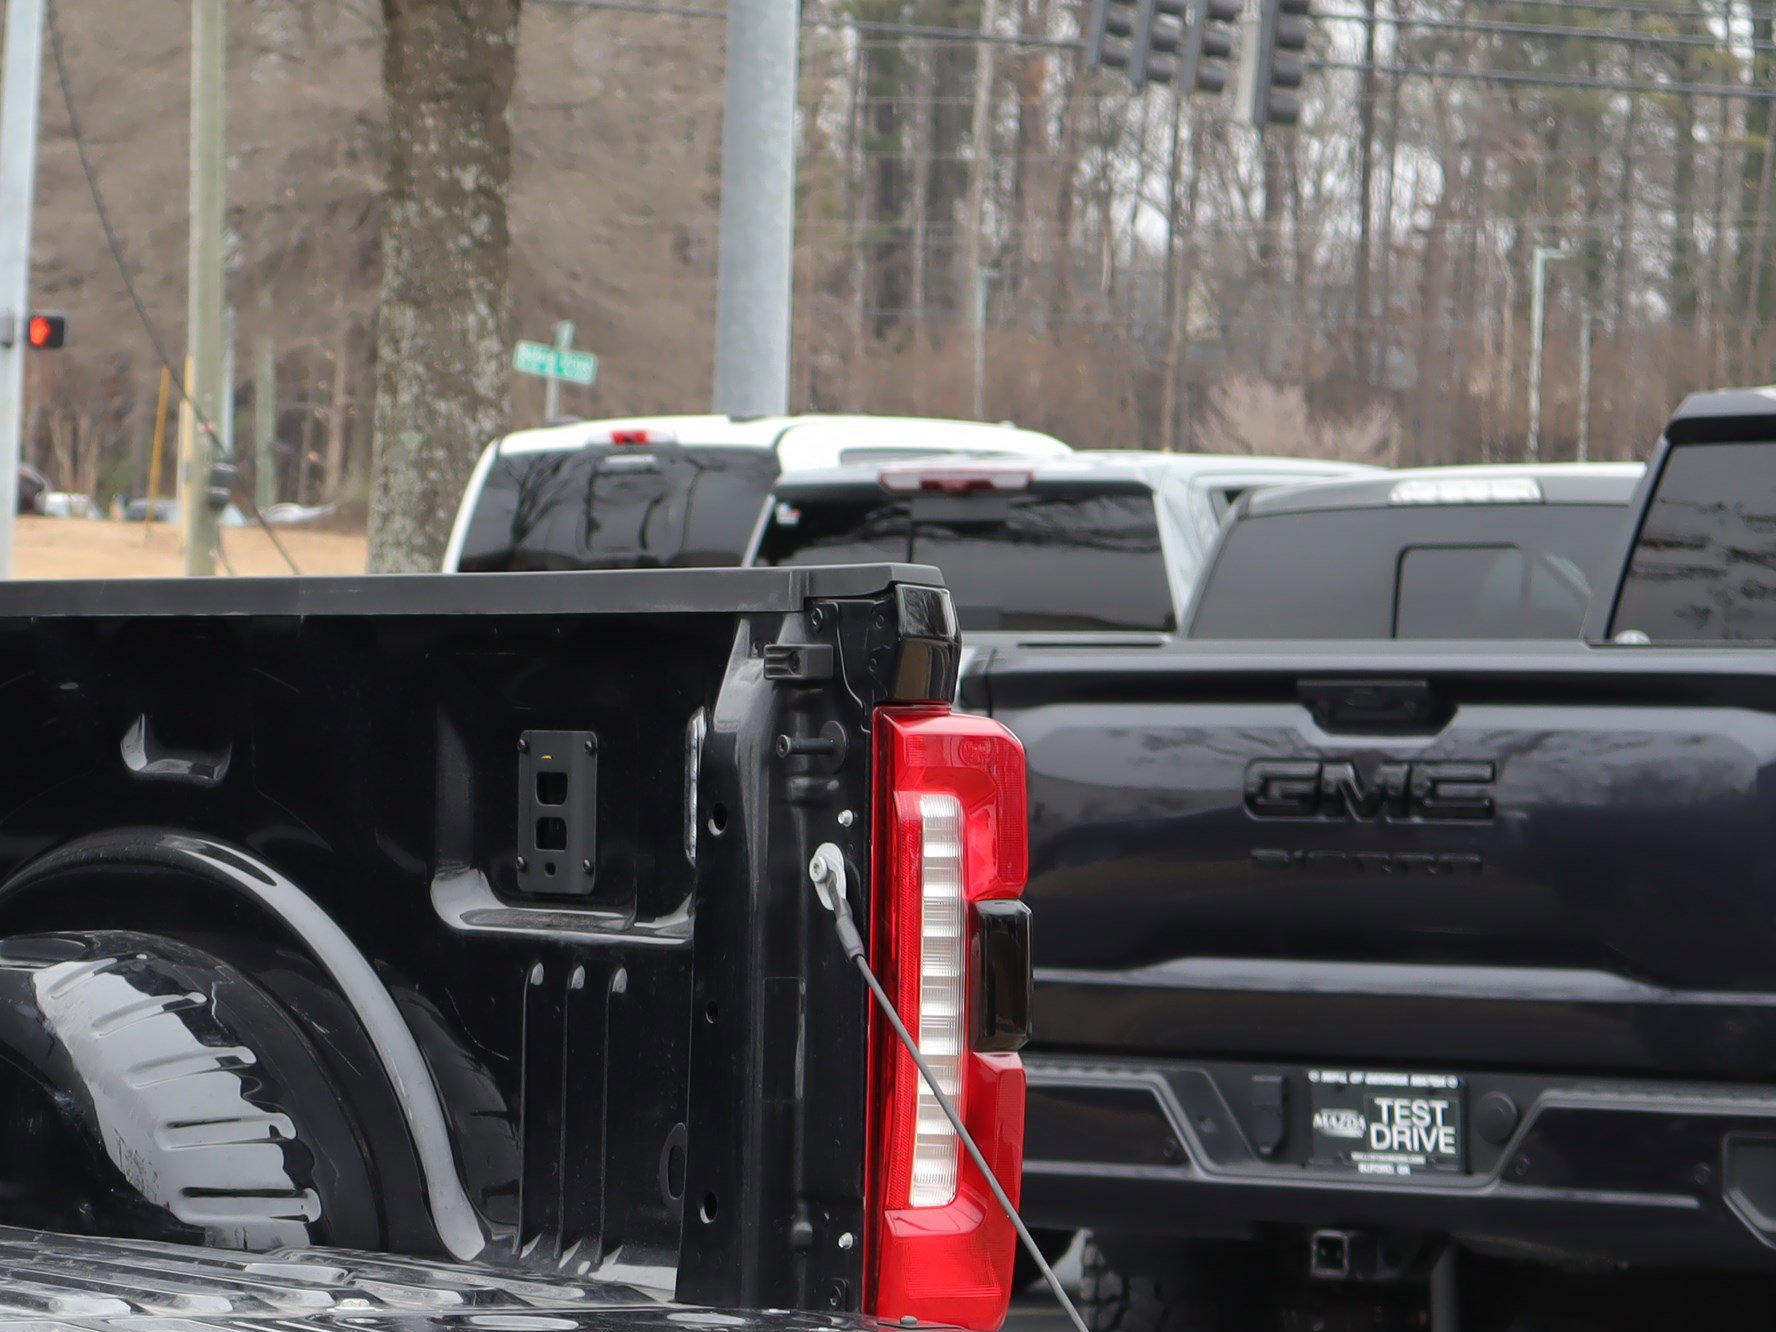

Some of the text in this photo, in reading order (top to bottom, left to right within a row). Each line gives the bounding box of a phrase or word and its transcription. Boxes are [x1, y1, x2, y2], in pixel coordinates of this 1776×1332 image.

[1244, 757, 1496, 825] GMC
[1374, 1097, 1449, 1127] TEST
[1370, 1122, 1456, 1154] DRIVE
